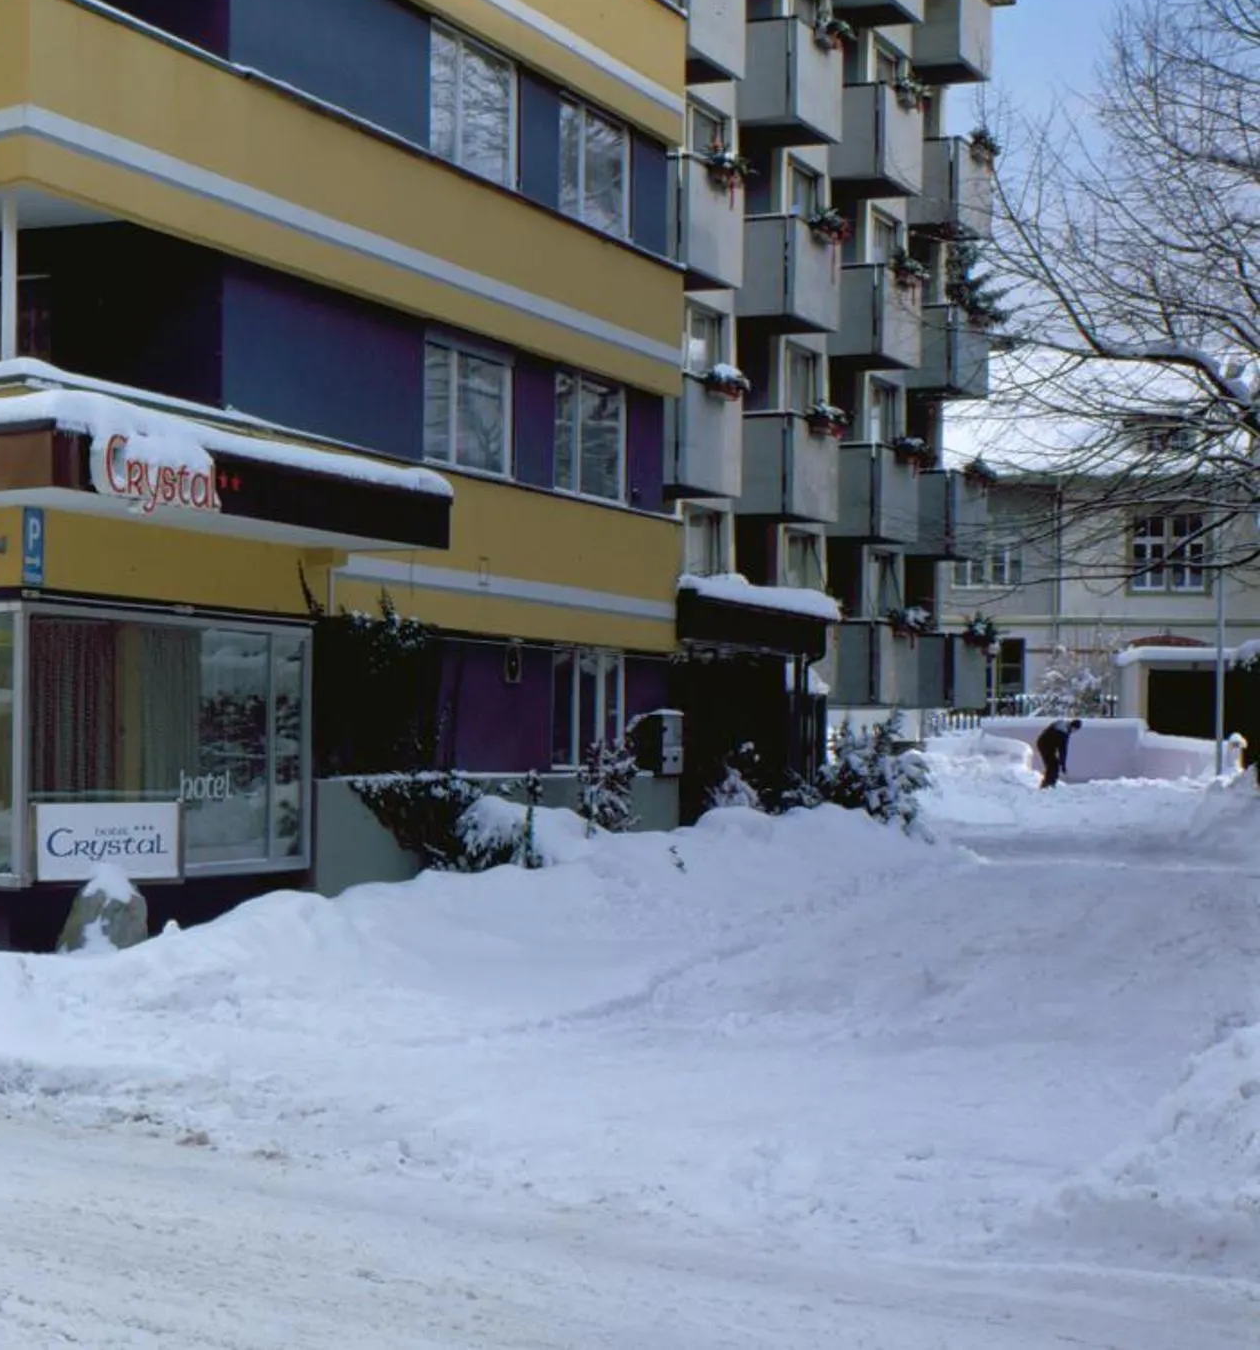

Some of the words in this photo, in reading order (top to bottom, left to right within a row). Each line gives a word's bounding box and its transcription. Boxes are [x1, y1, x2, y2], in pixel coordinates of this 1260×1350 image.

[104, 433, 221, 514] Crystal
[179, 769, 234, 800] hotel
[46, 827, 169, 862] Crystal
